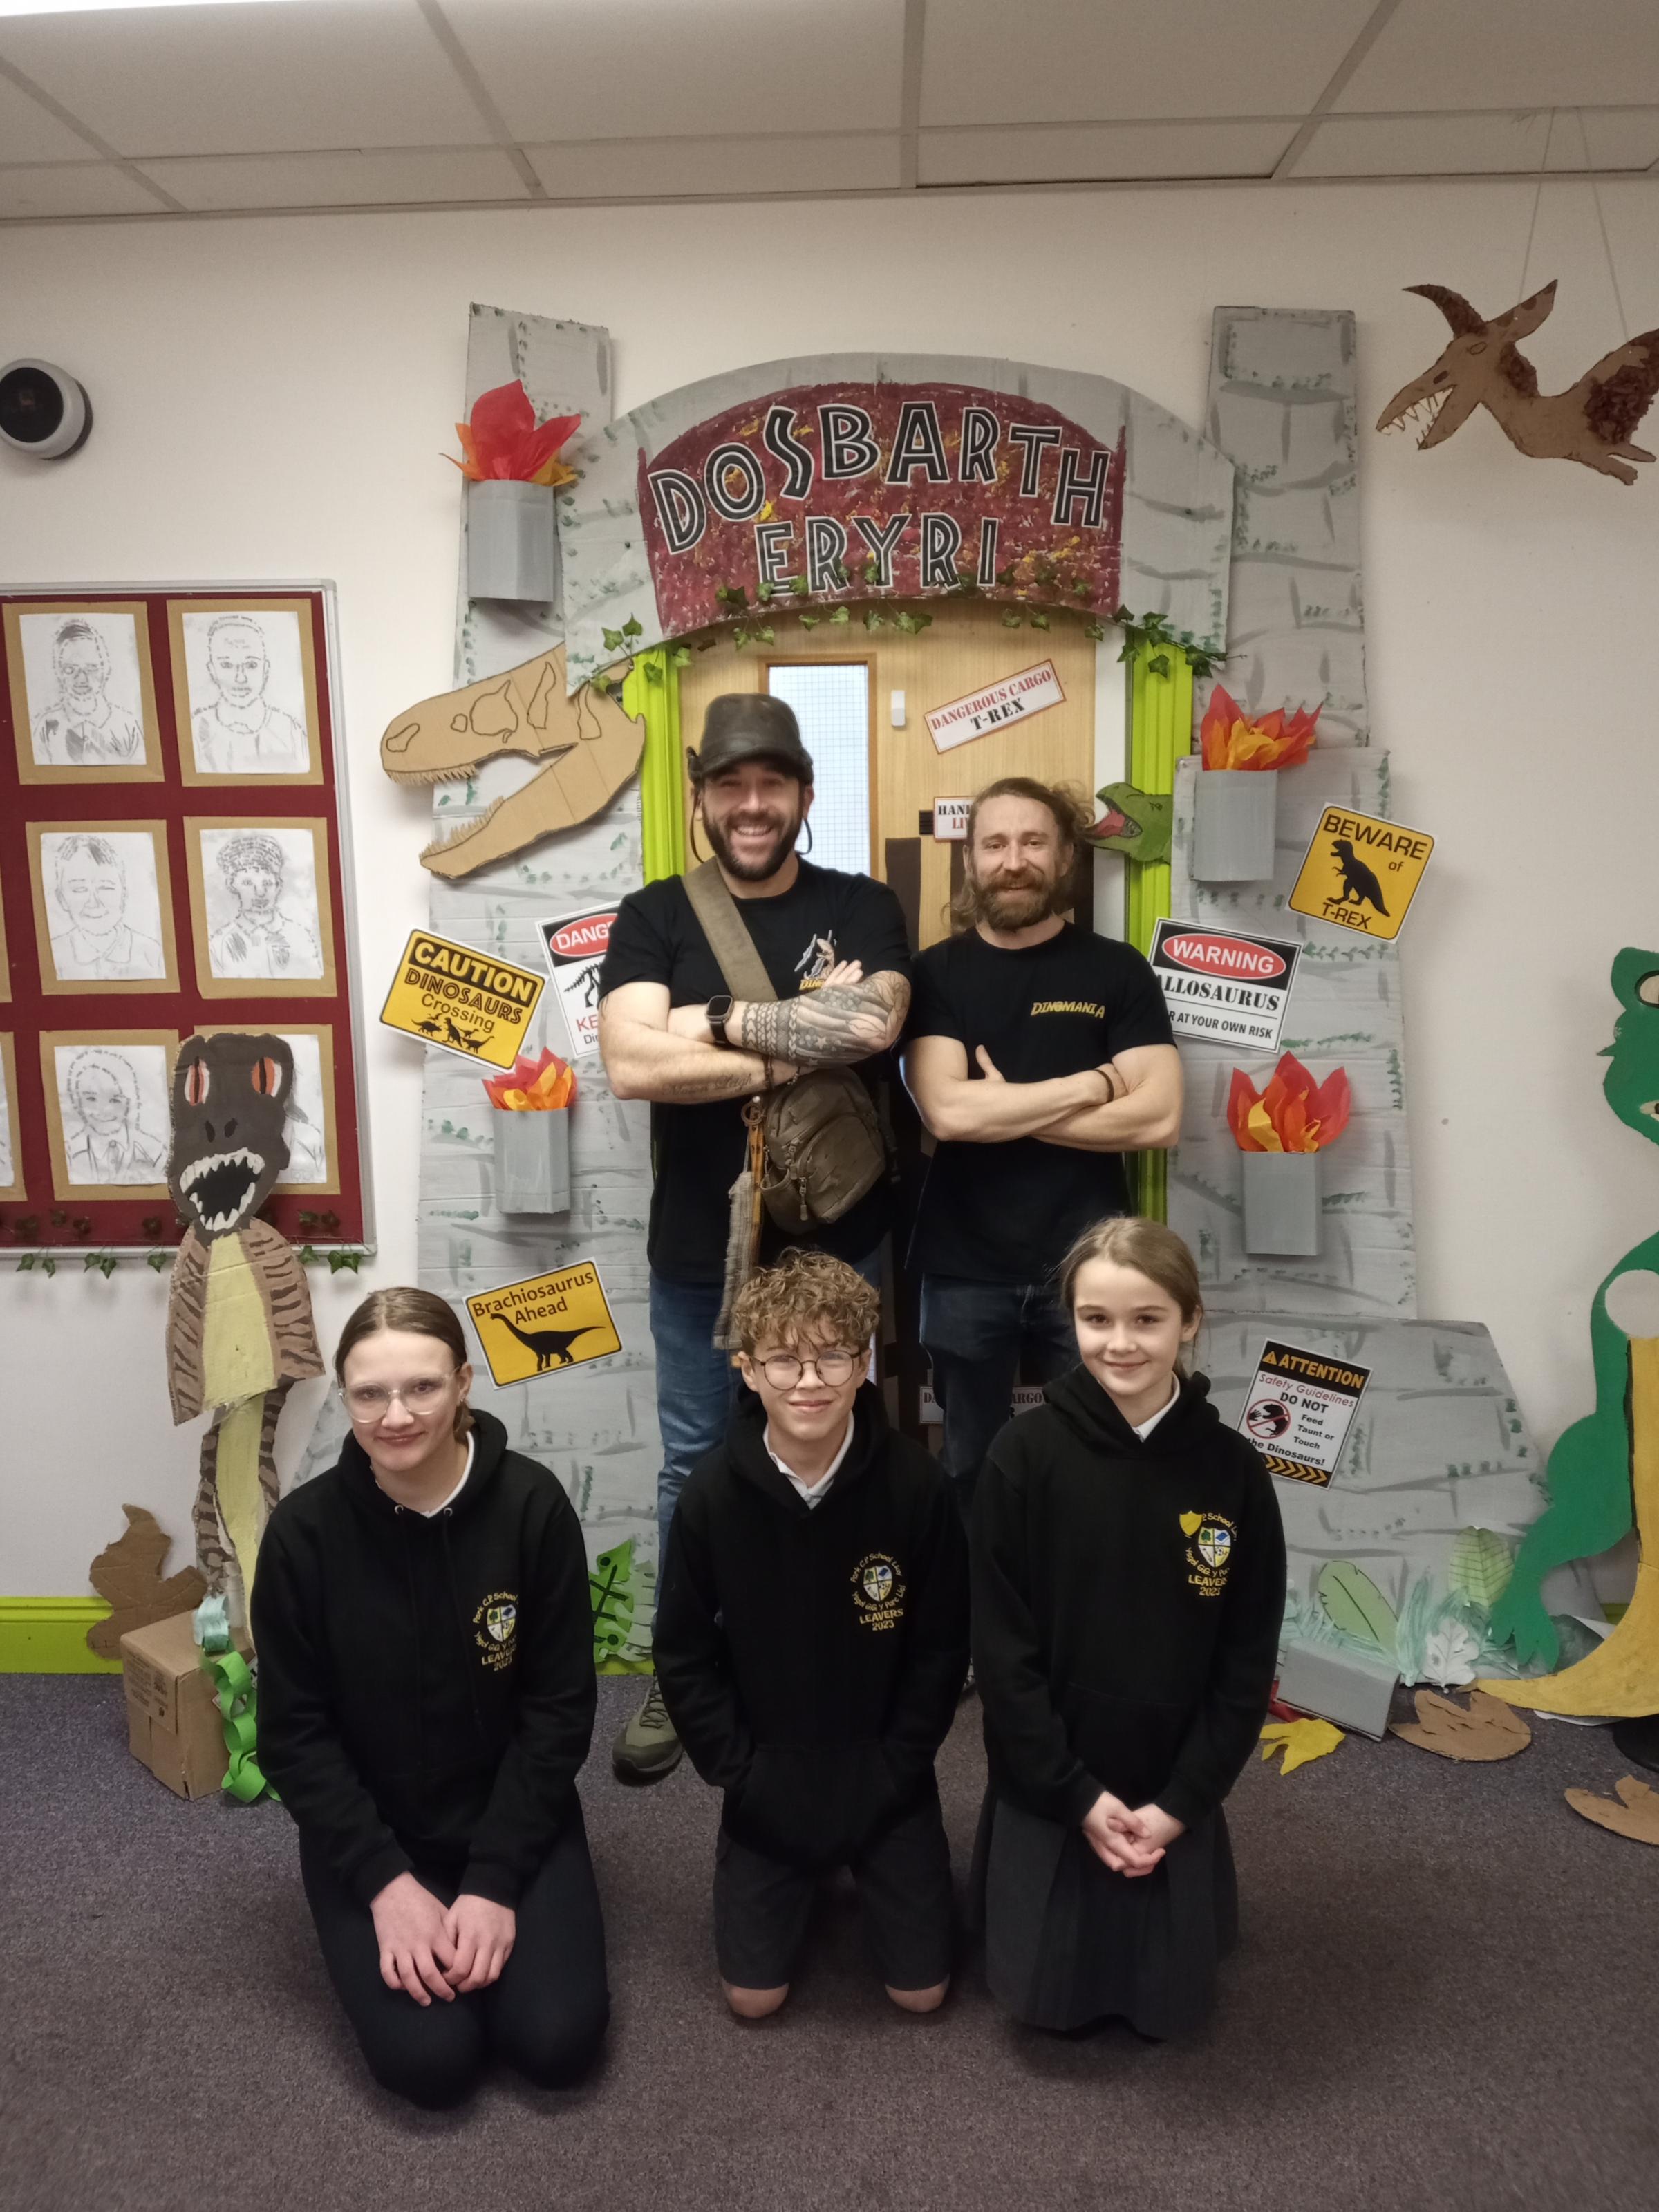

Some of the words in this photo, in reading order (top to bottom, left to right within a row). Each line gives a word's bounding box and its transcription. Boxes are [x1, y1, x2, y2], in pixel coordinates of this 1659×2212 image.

[648, 401, 1109, 554] DOSBARTH
[755, 512, 999, 596] ERYRI
[931, 688, 1007, 730] DANGEROUS
[1009, 669, 1051, 696] CARGO
[970, 697, 1026, 731] T-REX
[938, 805, 970, 815] HAN
[1322, 814, 1428, 860] BEWARE
[1388, 861, 1405, 872] of
[1322, 901, 1372, 930] T-REX
[556, 921, 614, 950] DANG
[1173, 939, 1275, 973] WARNING
[414, 941, 534, 1003] CAUTION
[404, 968, 523, 1024] DINOSAURS
[1031, 1001, 1105, 1018] DINOMANIA
[422, 993, 495, 1033] Crossing
[576, 1015, 598, 1032] KE
[1177, 1013, 1190, 1023] AT
[1192, 1015, 1219, 1029] YOUR
[1221, 1020, 1247, 1034] OWN
[1248, 1025, 1273, 1039] RISK
[472, 1271, 594, 1318] Brachiosaurus
[515, 1296, 568, 1324] Ahead
[1278, 1354, 1365, 1389] ATTENTION
[1259, 1374, 1293, 1391] Safety
[1297, 1385, 1354, 1407] Guidelines
[1280, 1392, 1298, 1405] DO
[1301, 1398, 1329, 1414] NOT
[1297, 1424, 1322, 1437] Taunt
[1301, 1414, 1324, 1425] Feed
[1248, 1438, 1264, 1449] the
[1267, 1443, 1326, 1466] Dinosaurs!
[1293, 1436, 1320, 1450] Touch
[869, 1551, 893, 1563] School
[859, 1609, 903, 1624] LEAVERS
[872, 1620, 894, 1631] 2023
